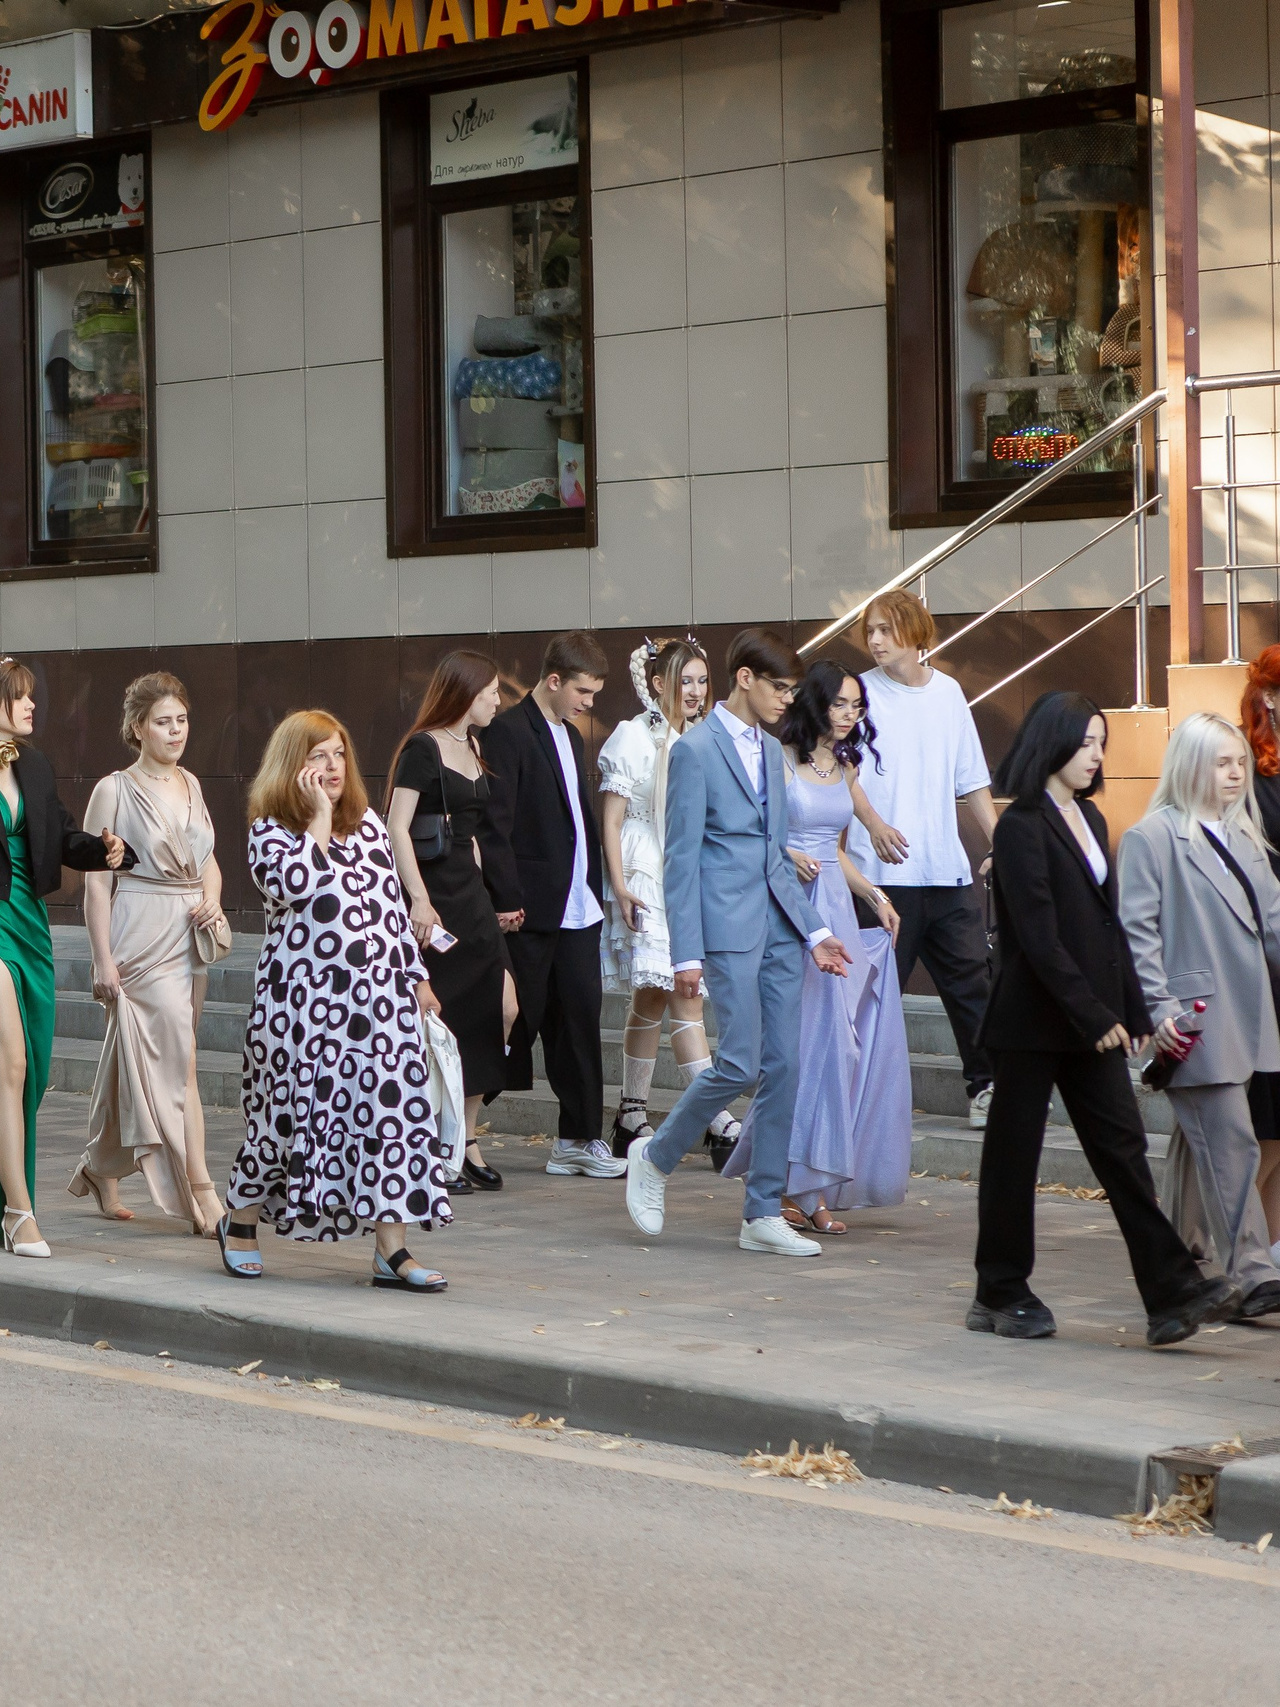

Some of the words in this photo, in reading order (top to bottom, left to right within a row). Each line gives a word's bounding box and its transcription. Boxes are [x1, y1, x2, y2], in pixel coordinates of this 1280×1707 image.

[198, 0, 696, 131] ЗООМАГА
[446, 108, 497, 143] Sheba
[434, 164, 454, 179] Для
[496, 154, 525, 170] натур
[992, 434, 1079, 460] ОТКРЫТО
